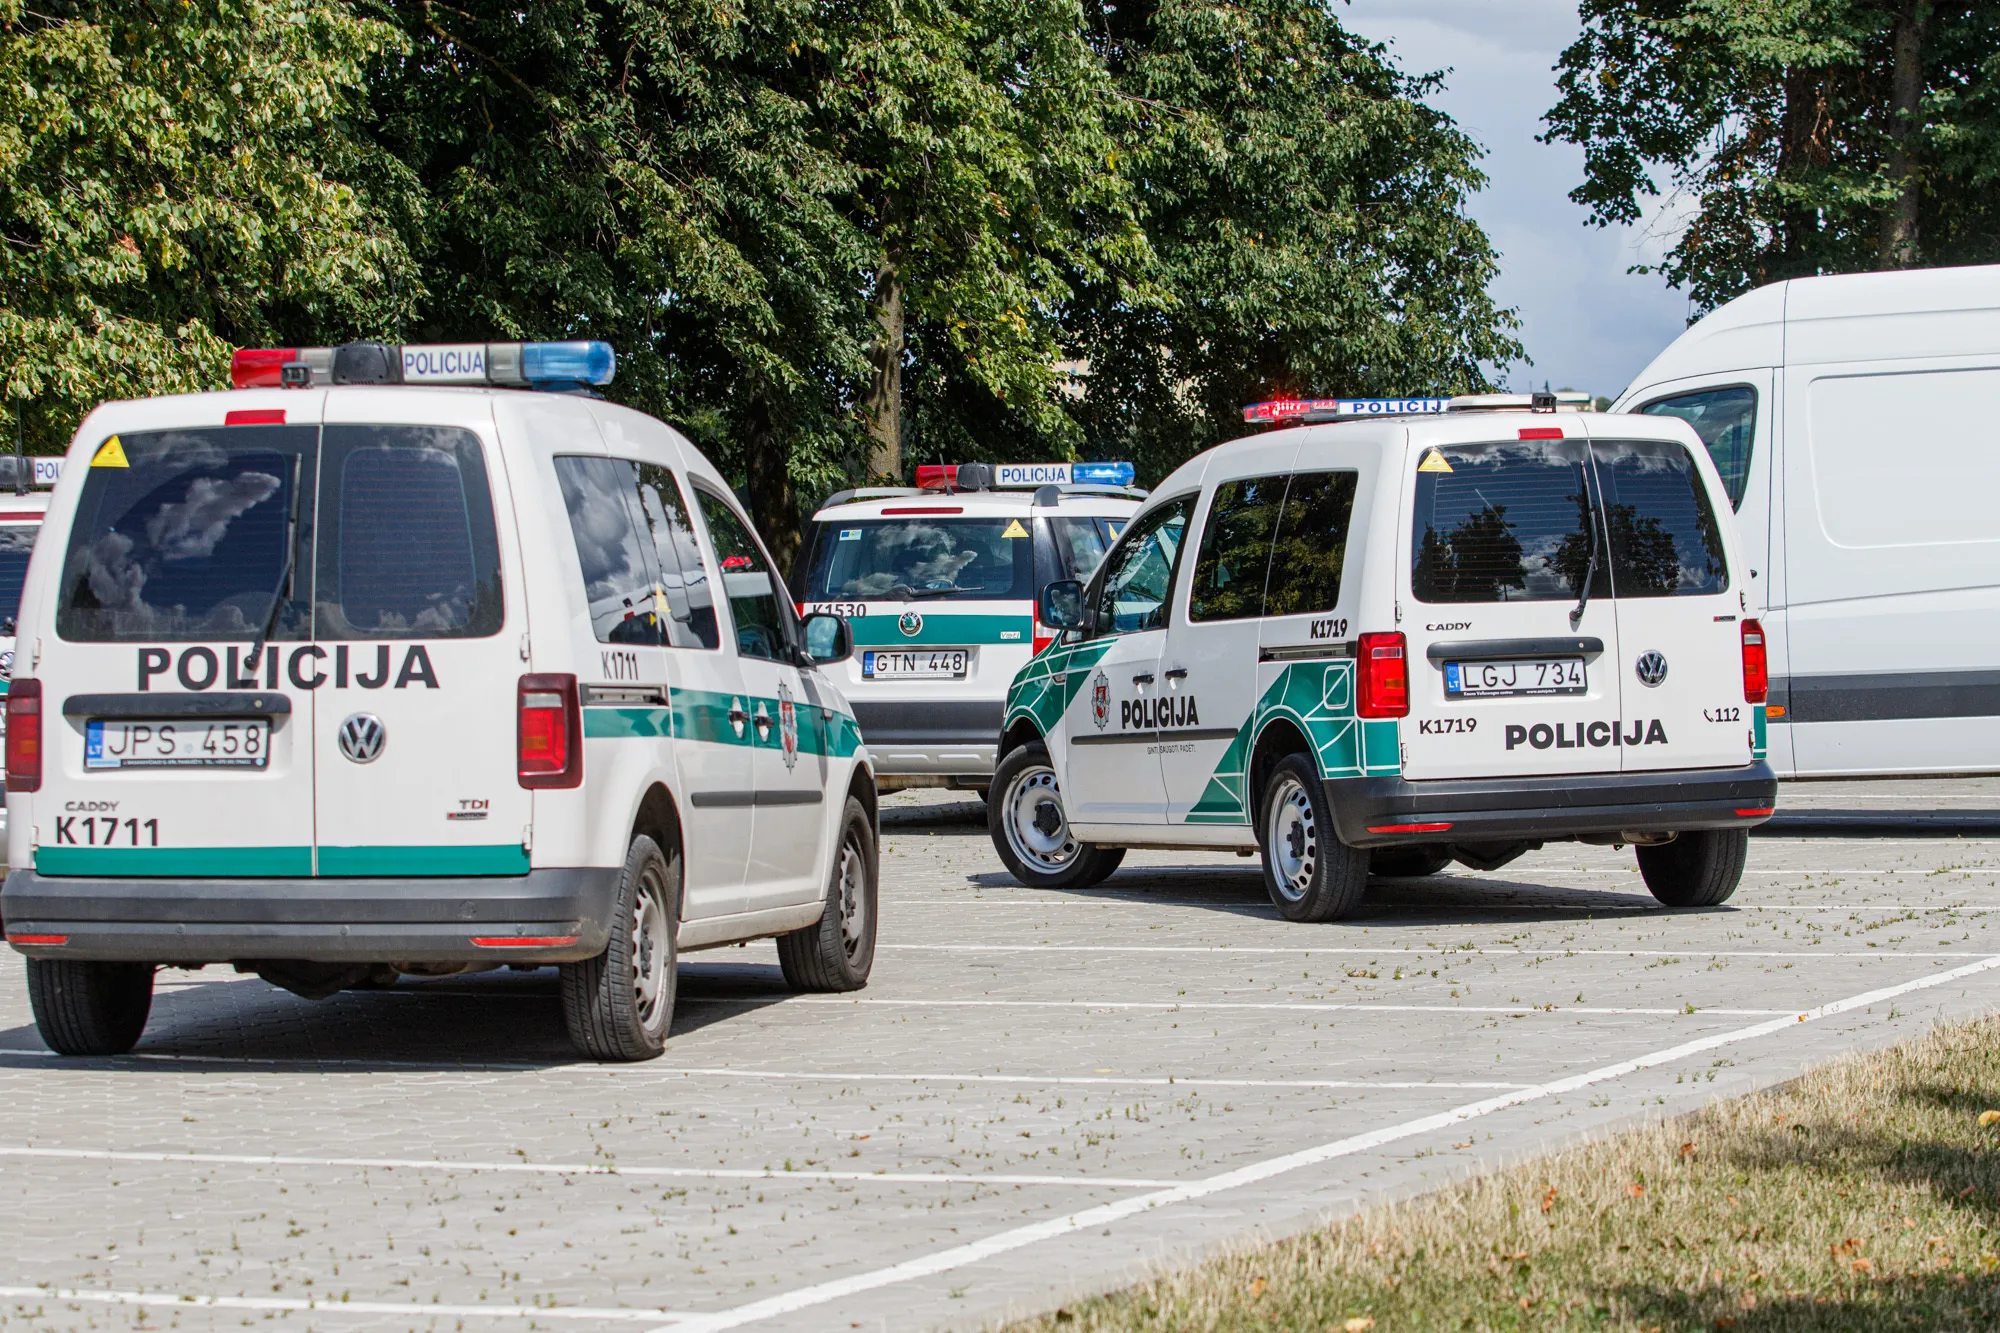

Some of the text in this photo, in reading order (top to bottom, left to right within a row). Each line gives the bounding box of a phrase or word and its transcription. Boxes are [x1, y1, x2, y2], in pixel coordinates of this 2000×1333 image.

[404, 351, 485, 375] POLICIJA
[1353, 400, 1442, 413] POLICIJ
[1001, 467, 1066, 482] POLICIJA
[813, 603, 867, 619] K1530
[1310, 618, 1348, 639] K1719
[1425, 621, 1472, 631] CADDY
[138, 645, 440, 691] POLICIJA
[601, 651, 639, 680] K1711
[876, 653, 916, 671] GTN
[929, 653, 962, 671] 448
[1463, 664, 1516, 688] LGJ
[1536, 662, 1580, 686] 734
[1121, 695, 1199, 729] POLICIJA
[1716, 707, 1740, 722] 112
[1419, 717, 1477, 734] K1719
[1505, 719, 1668, 750] POLICIJA
[88, 725, 260, 755] LT JPS 458
[65, 801, 119, 812] CADDY
[459, 799, 489, 810] TDI
[56, 816, 159, 847] K1711
